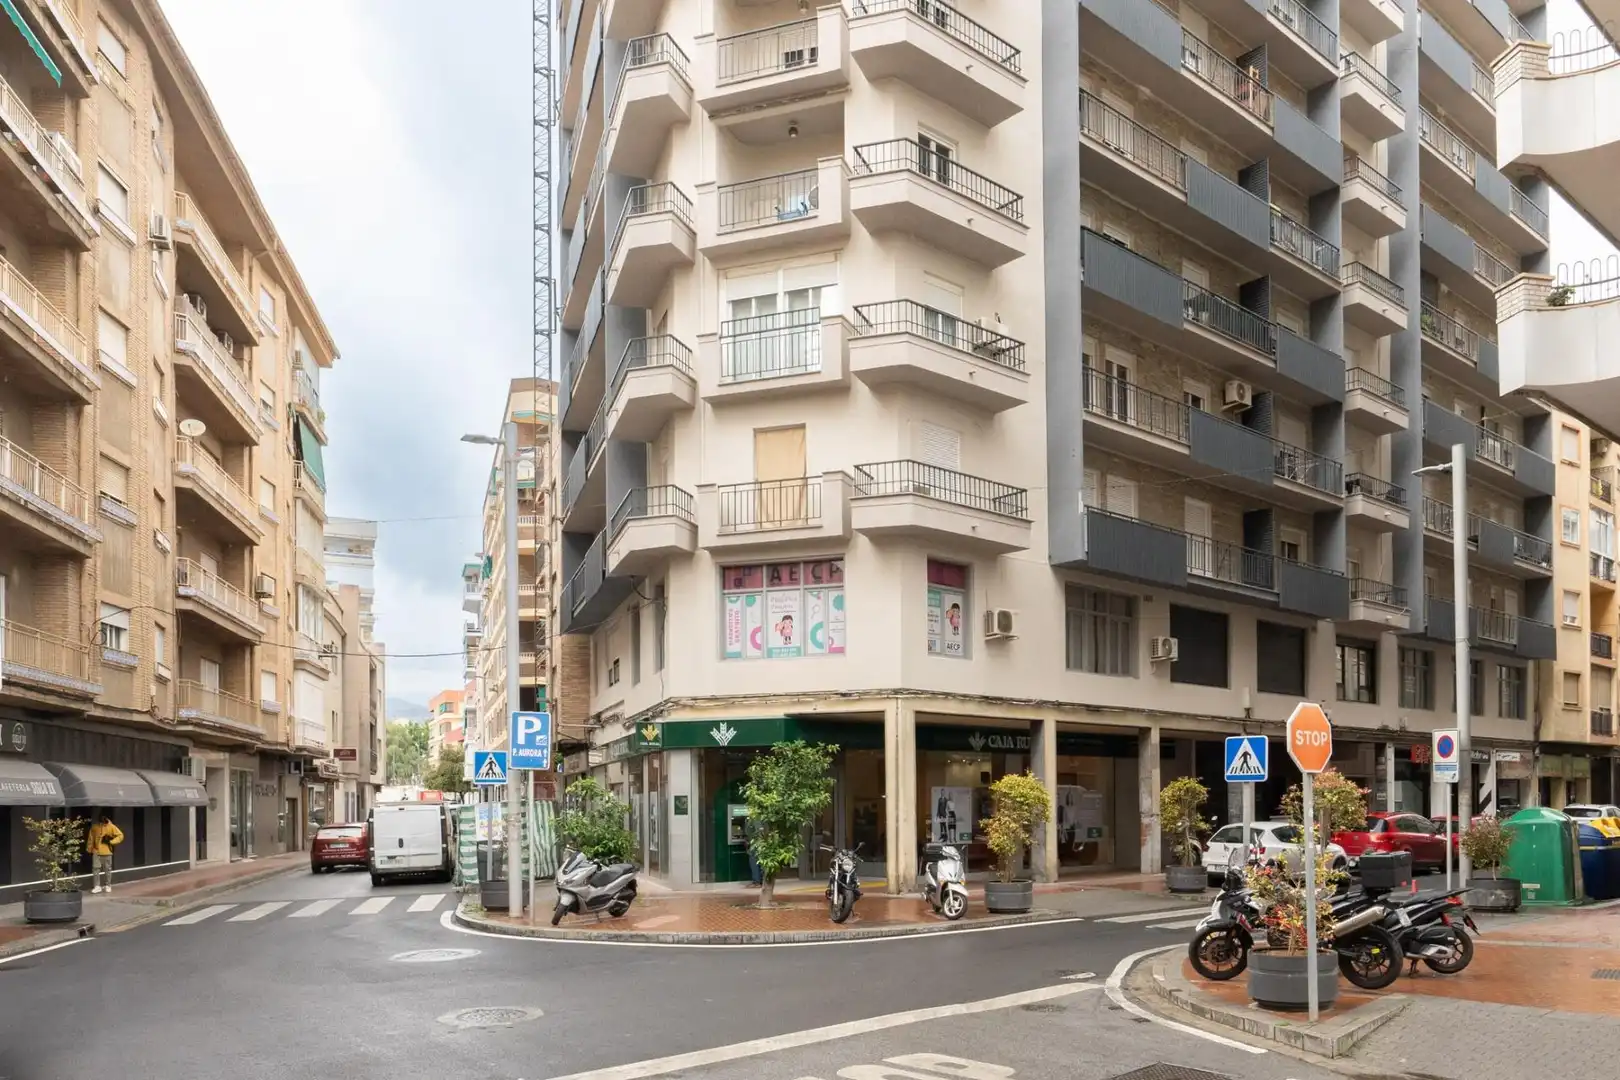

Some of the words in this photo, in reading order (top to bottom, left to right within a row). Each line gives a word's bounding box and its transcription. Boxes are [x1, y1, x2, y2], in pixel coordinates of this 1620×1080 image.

[517, 716, 542, 745] P
[988, 735, 1014, 749] CAJA
[1295, 729, 1328, 747] STOP
[518, 748, 542, 757] AURORA
[0, 782, 31, 792] AFETERIA
